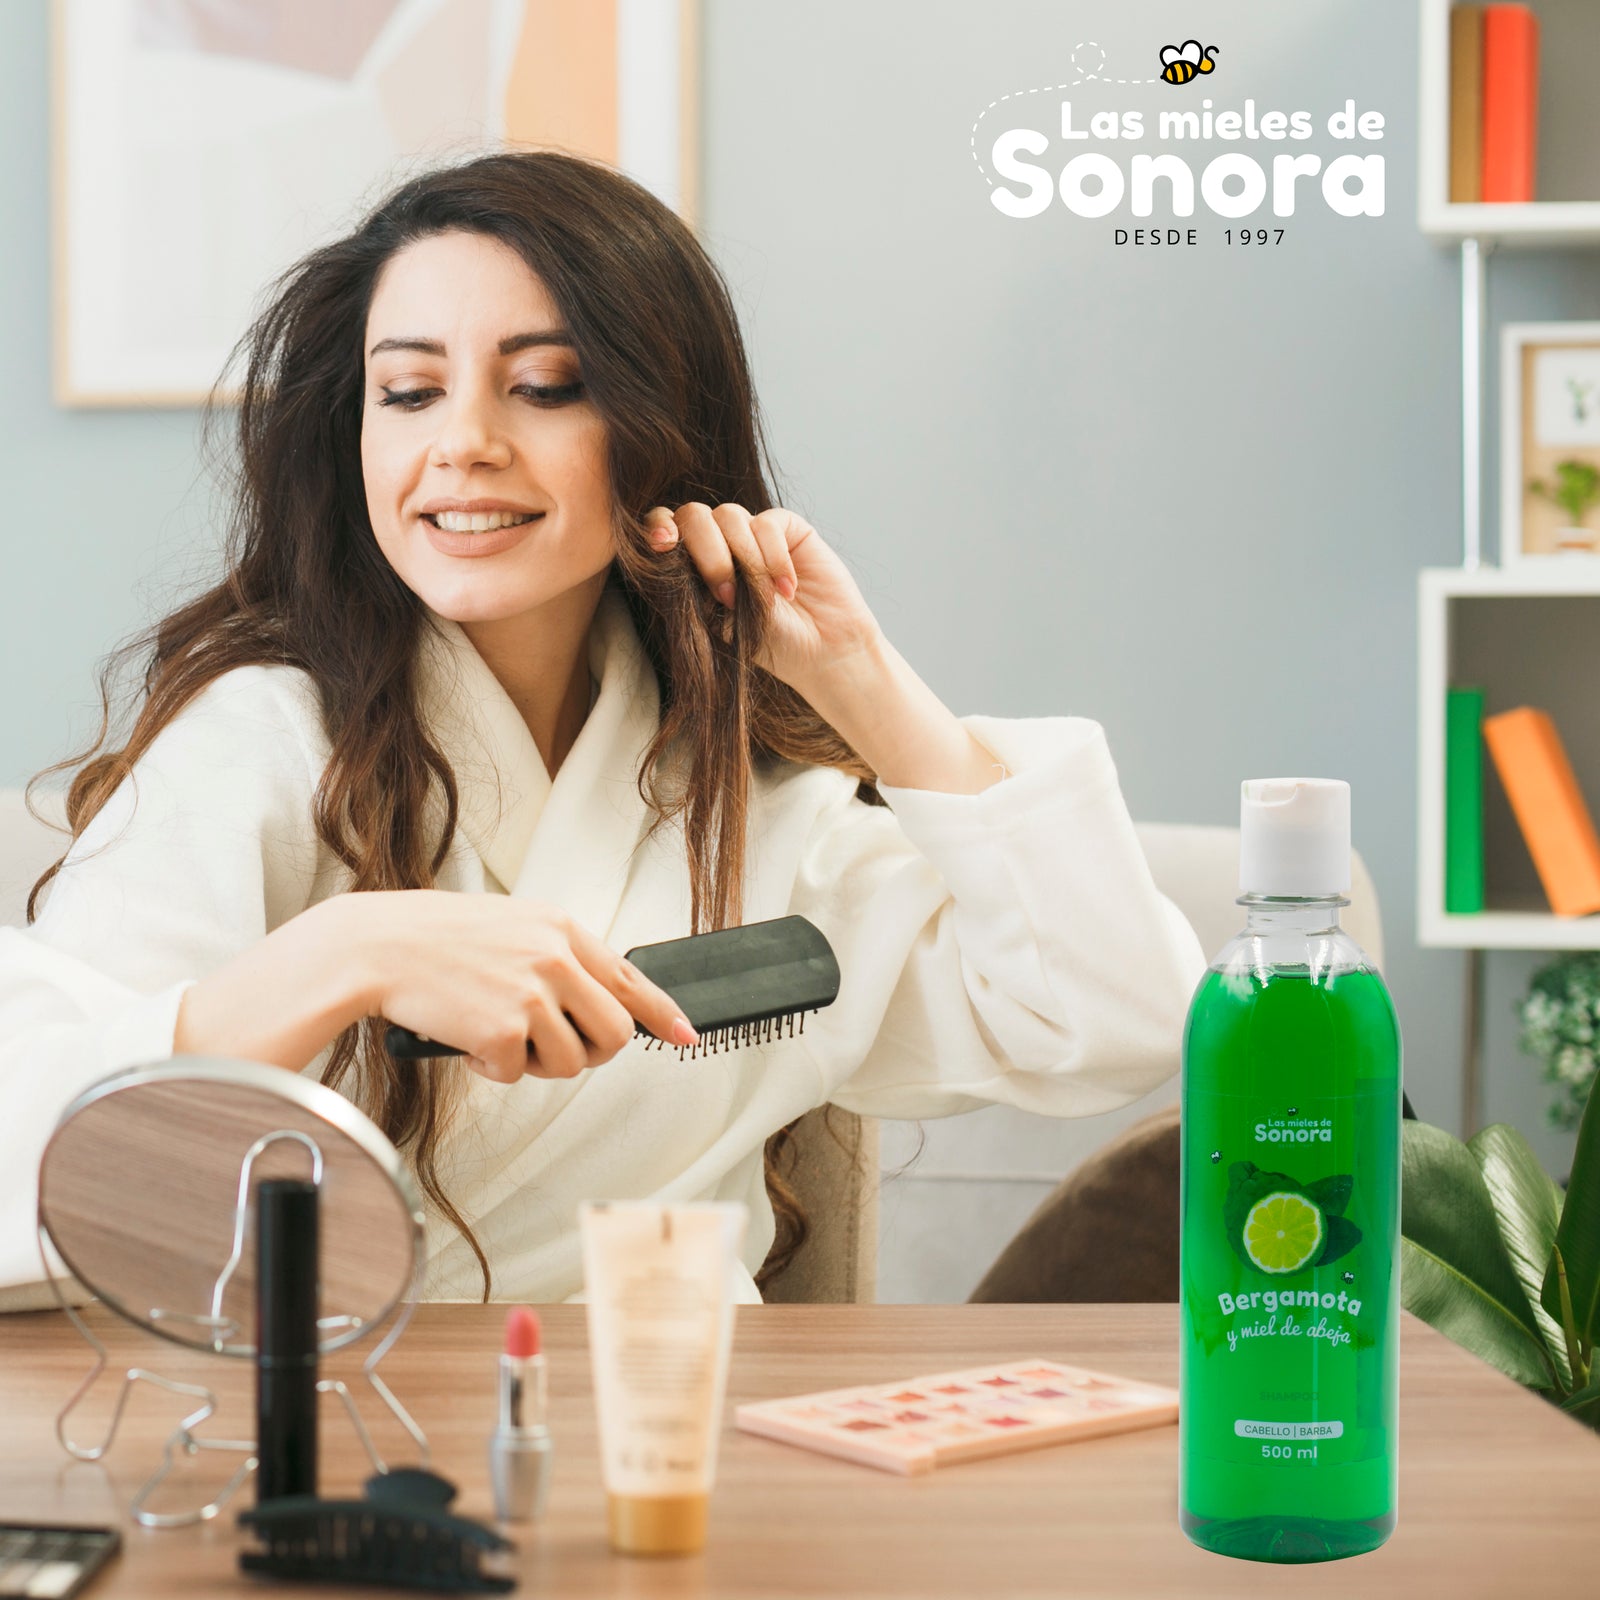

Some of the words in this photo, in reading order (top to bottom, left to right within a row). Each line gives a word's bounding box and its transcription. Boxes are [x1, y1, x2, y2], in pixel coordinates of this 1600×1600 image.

[1268, 1118, 1285, 1127] Las
[1287, 1118, 1318, 1127] mieles
[1320, 1118, 1332, 1127] de
[1254, 1124, 1332, 1142] Sonora
[1217, 1290, 1362, 1316] Bergamota
[1226, 1330, 1238, 1352] y
[1241, 1315, 1276, 1339] miel
[1280, 1315, 1303, 1337] de
[1307, 1317, 1351, 1347] abeja
[1244, 1424, 1291, 1437] CABELLO
[1299, 1425, 1333, 1437] BARBA
[1261, 1445, 1292, 1459] 500
[1296, 1445, 1318, 1459] ml
